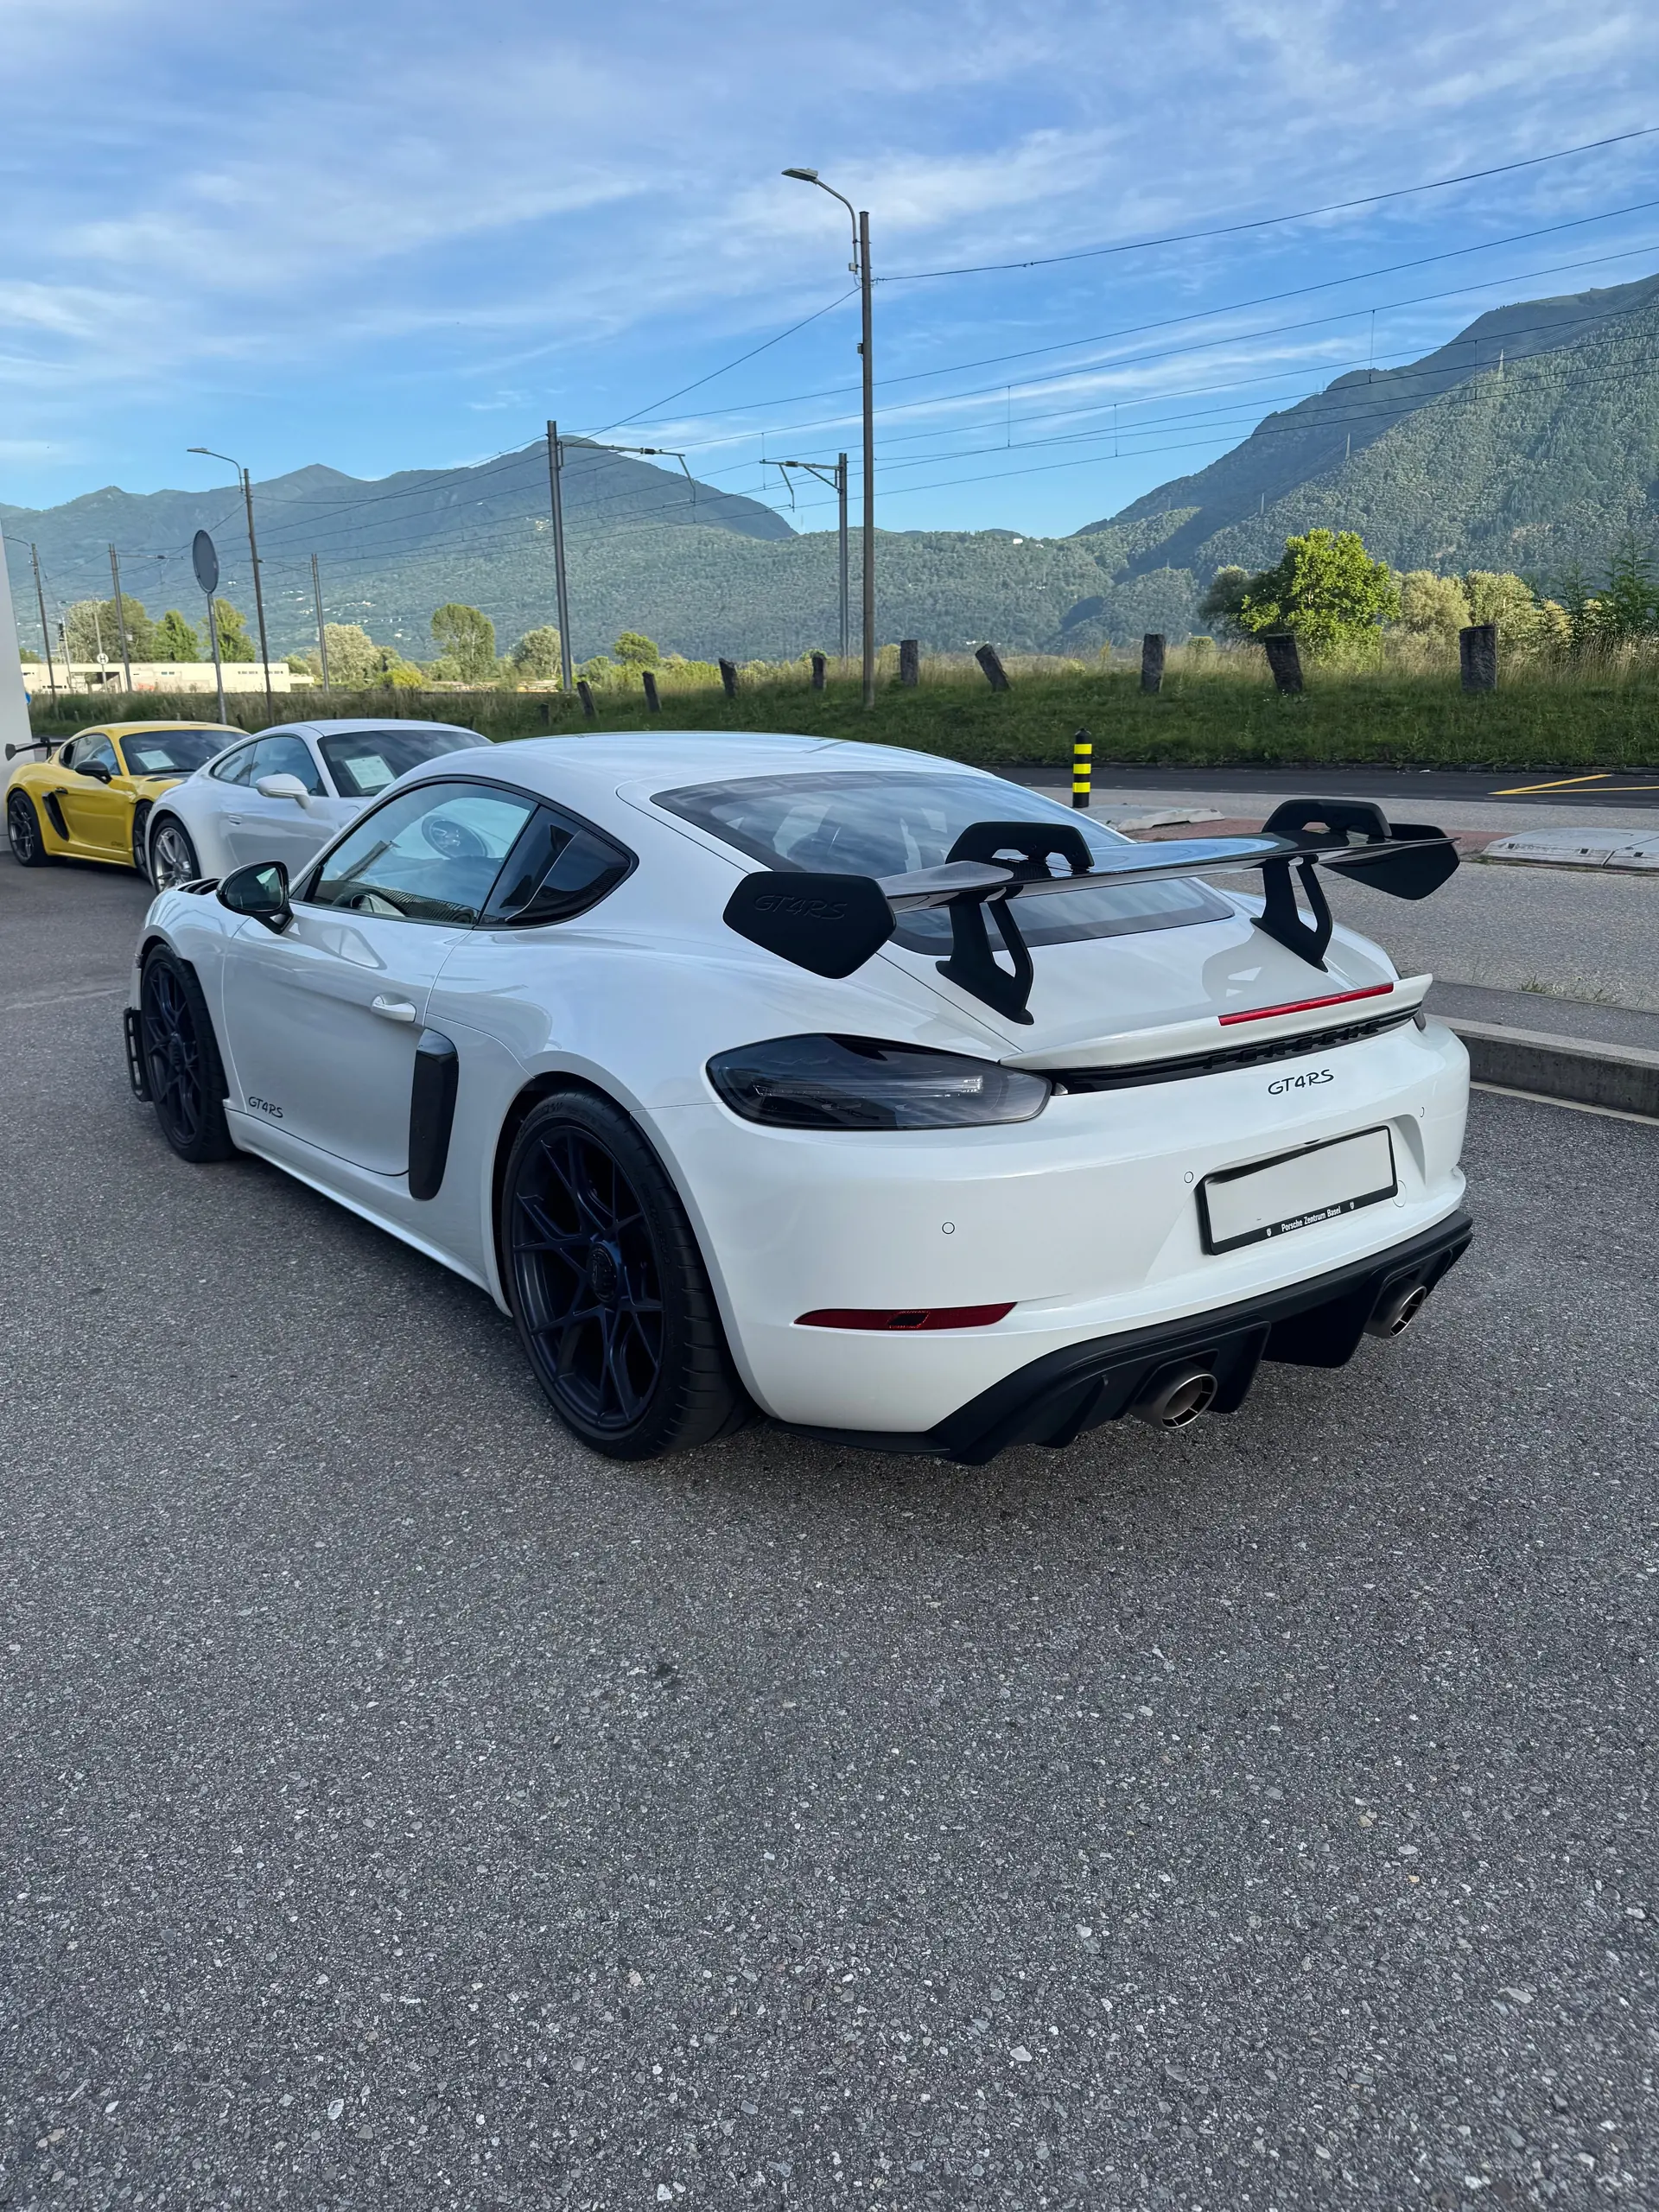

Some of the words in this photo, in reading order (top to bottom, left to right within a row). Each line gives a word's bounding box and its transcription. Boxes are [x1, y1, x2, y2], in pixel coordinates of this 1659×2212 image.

[753, 894, 848, 919] GT4RS
[1204, 1022, 1380, 1069] PORSCHE
[1268, 1069, 1335, 1096] GT4RS
[249, 1096, 283, 1118] GT4RS
[1281, 1219, 1302, 1232] Porsche
[1304, 1212, 1325, 1224] Zentrum
[1327, 1206, 1341, 1217] Basel
